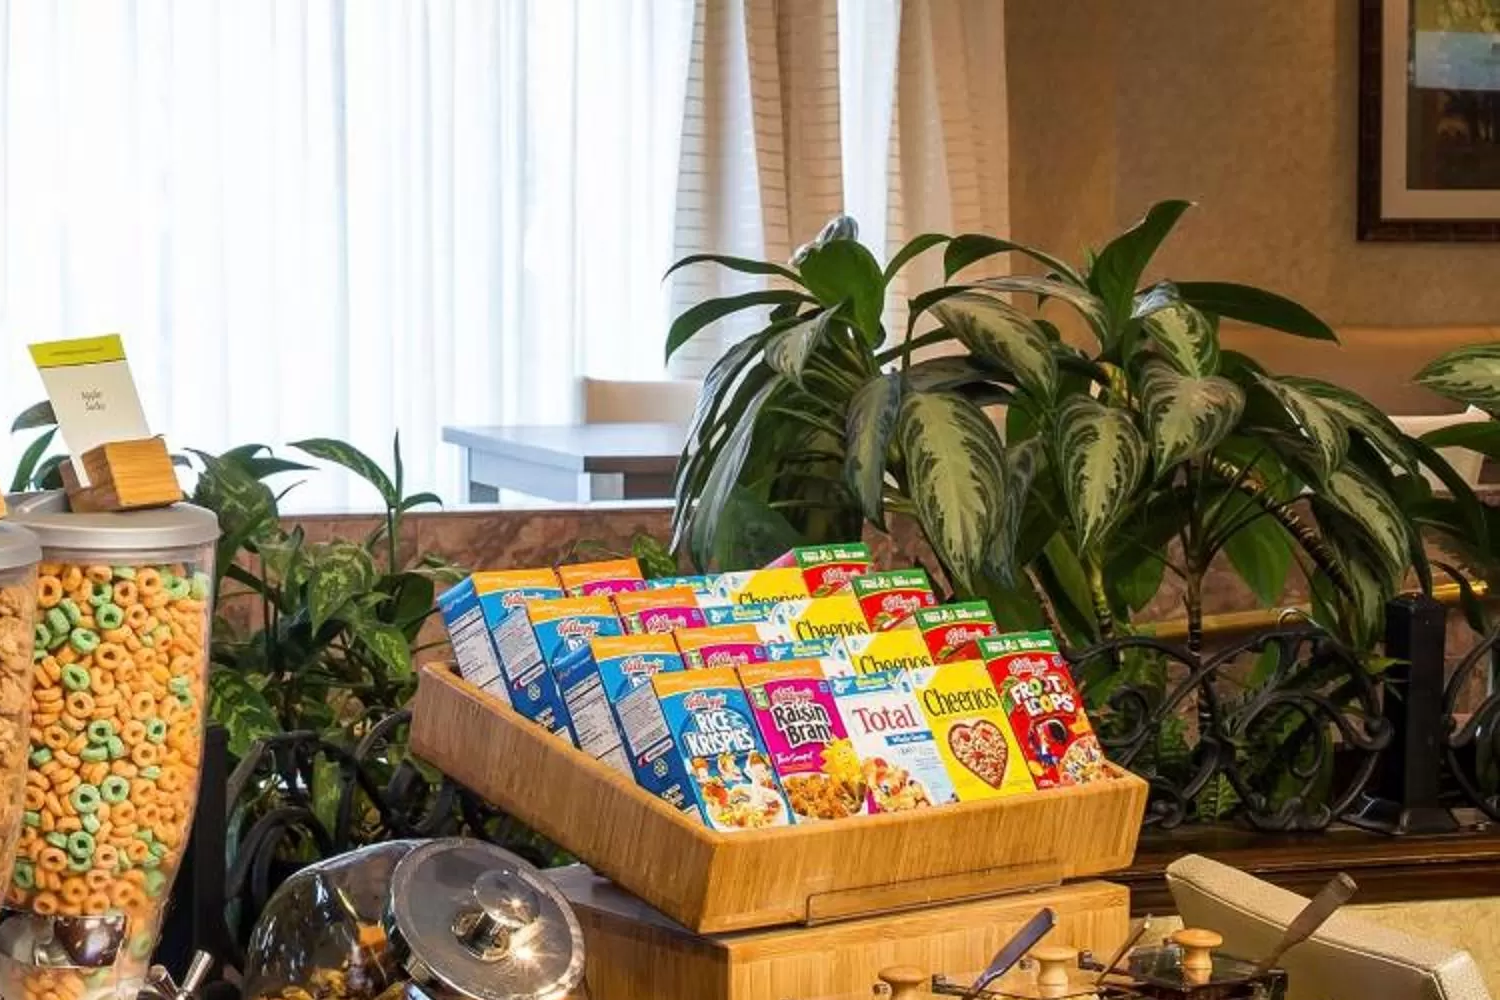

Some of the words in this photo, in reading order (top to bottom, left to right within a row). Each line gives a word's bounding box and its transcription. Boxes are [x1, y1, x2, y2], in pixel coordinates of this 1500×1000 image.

[773, 703, 829, 729] Raisin
[923, 687, 999, 717] Cheerios
[693, 711, 732, 733] RICE
[852, 703, 920, 735] Total
[683, 729, 756, 758] KRISPIES
[787, 721, 832, 748] Bran
